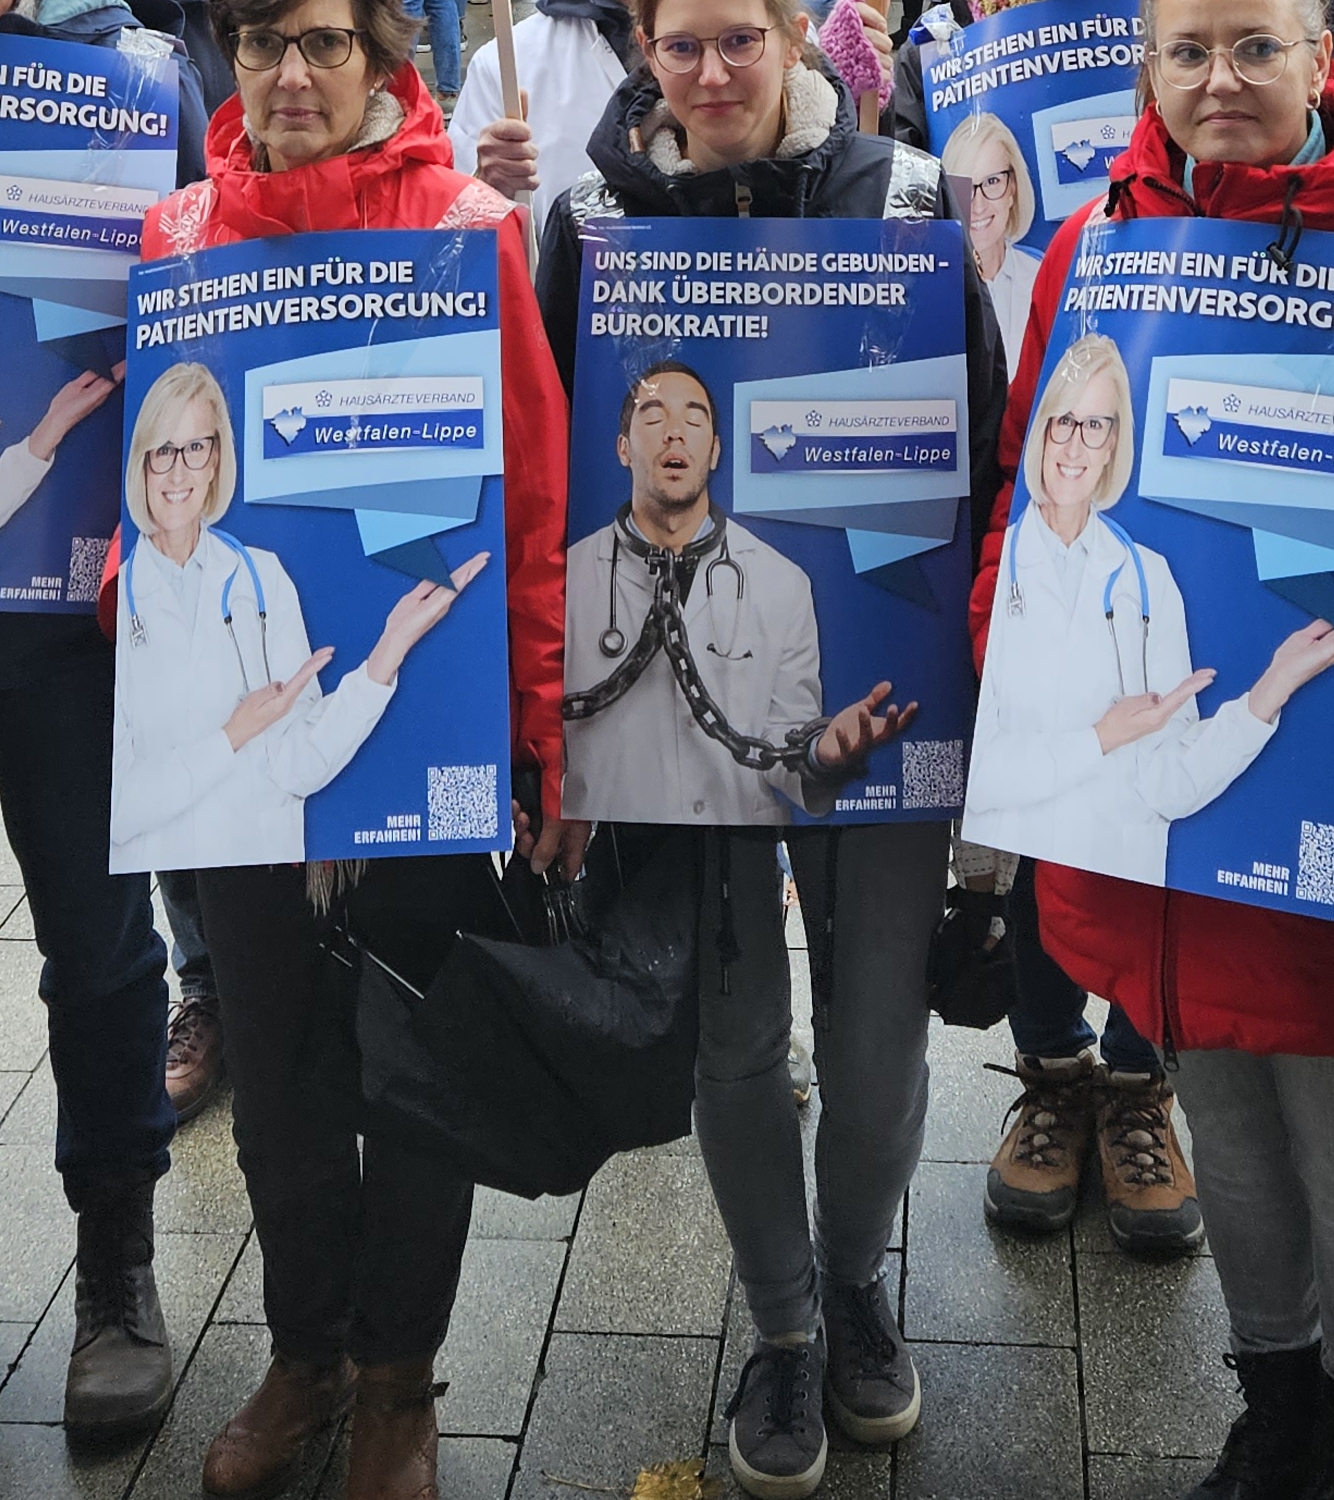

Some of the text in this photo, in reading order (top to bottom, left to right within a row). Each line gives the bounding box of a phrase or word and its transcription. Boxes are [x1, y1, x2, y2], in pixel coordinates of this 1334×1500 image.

[595, 247, 934, 273] UNS SIND DIE HÄNDE GEBUNDEN
[1074, 255, 1102, 278] WIR
[1103, 252, 1176, 274] STEHEN
[1181, 252, 1224, 278] EIN
[137, 257, 413, 316] WIR STEHEN EIN FÜR DIE
[593, 275, 906, 306] DANK ÜBERBORDENDER
[136, 292, 486, 350] PATIENTENVERSORGUNG!
[591, 307, 767, 338] BÜROKRATIE!
[340, 392, 475, 406] HAUSÄRZTEVERBAND
[829, 415, 949, 427] HAUSÄRZTEVERBAND
[315, 423, 477, 444] Westfalen-Lippe
[805, 447, 951, 465] Westfalen-Lippe
[866, 786, 896, 797] MEHR
[836, 799, 896, 811] ERFAHREN!
[1218, 870, 1288, 895] ERFAHREN!
[1253, 862, 1290, 880] MEHR
